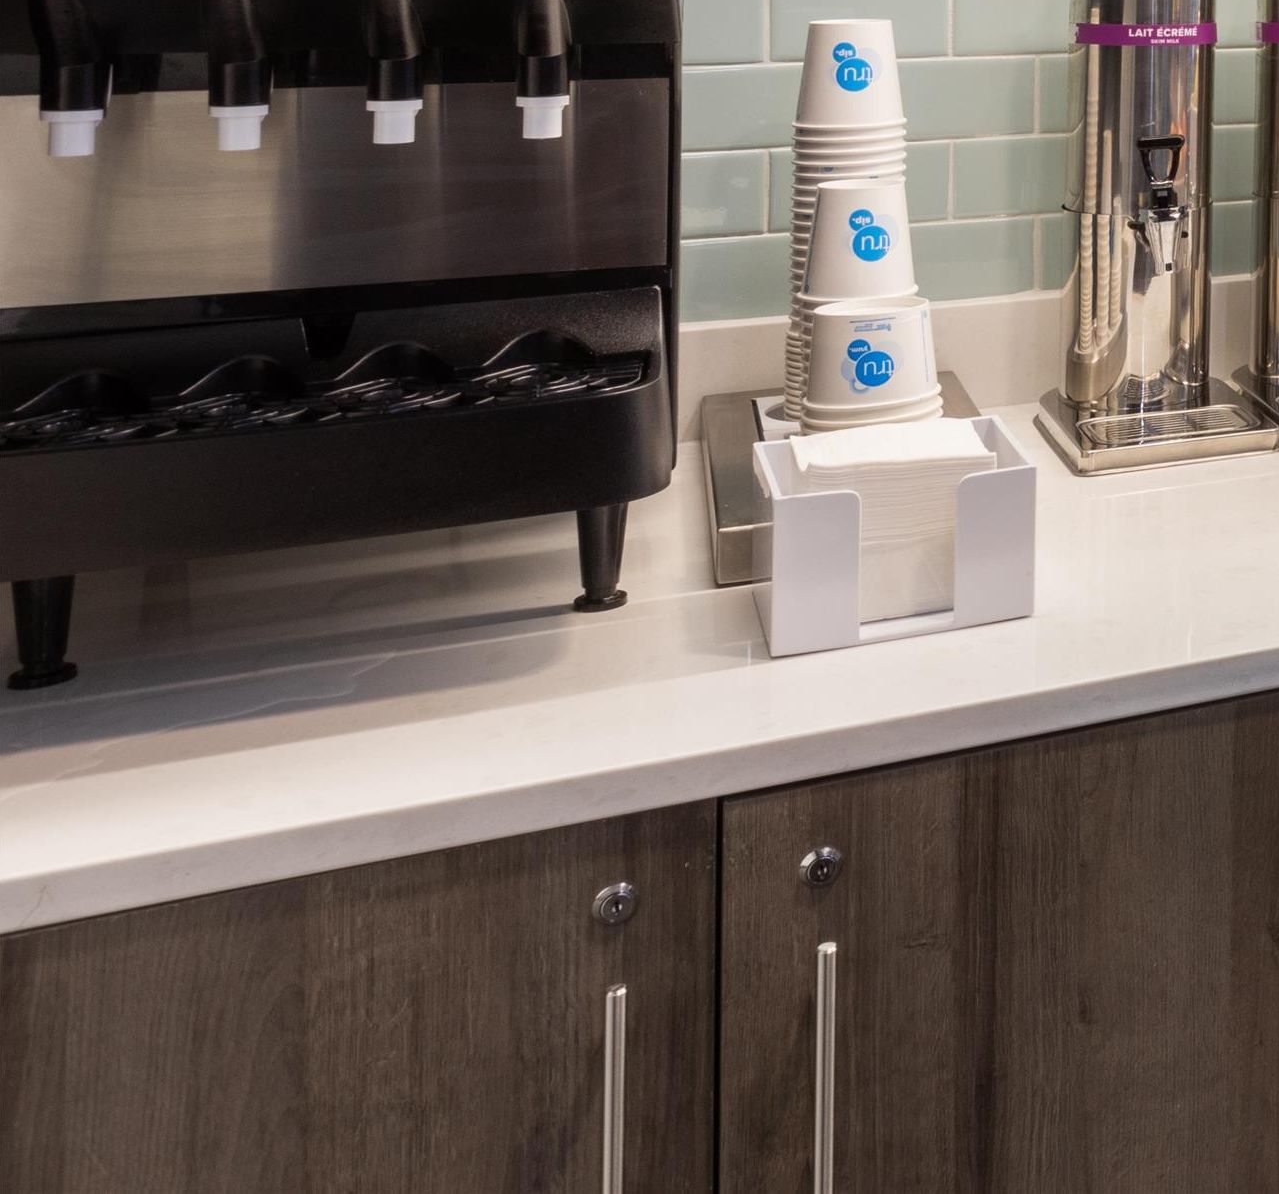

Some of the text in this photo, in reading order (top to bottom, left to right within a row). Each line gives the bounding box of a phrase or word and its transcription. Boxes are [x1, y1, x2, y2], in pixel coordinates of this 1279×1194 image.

[1128, 26, 1198, 37] LAIT ÉCRÉMÉ
[844, 67, 874, 83] tru
[861, 235, 891, 251] tru
[863, 359, 893, 376] tru
